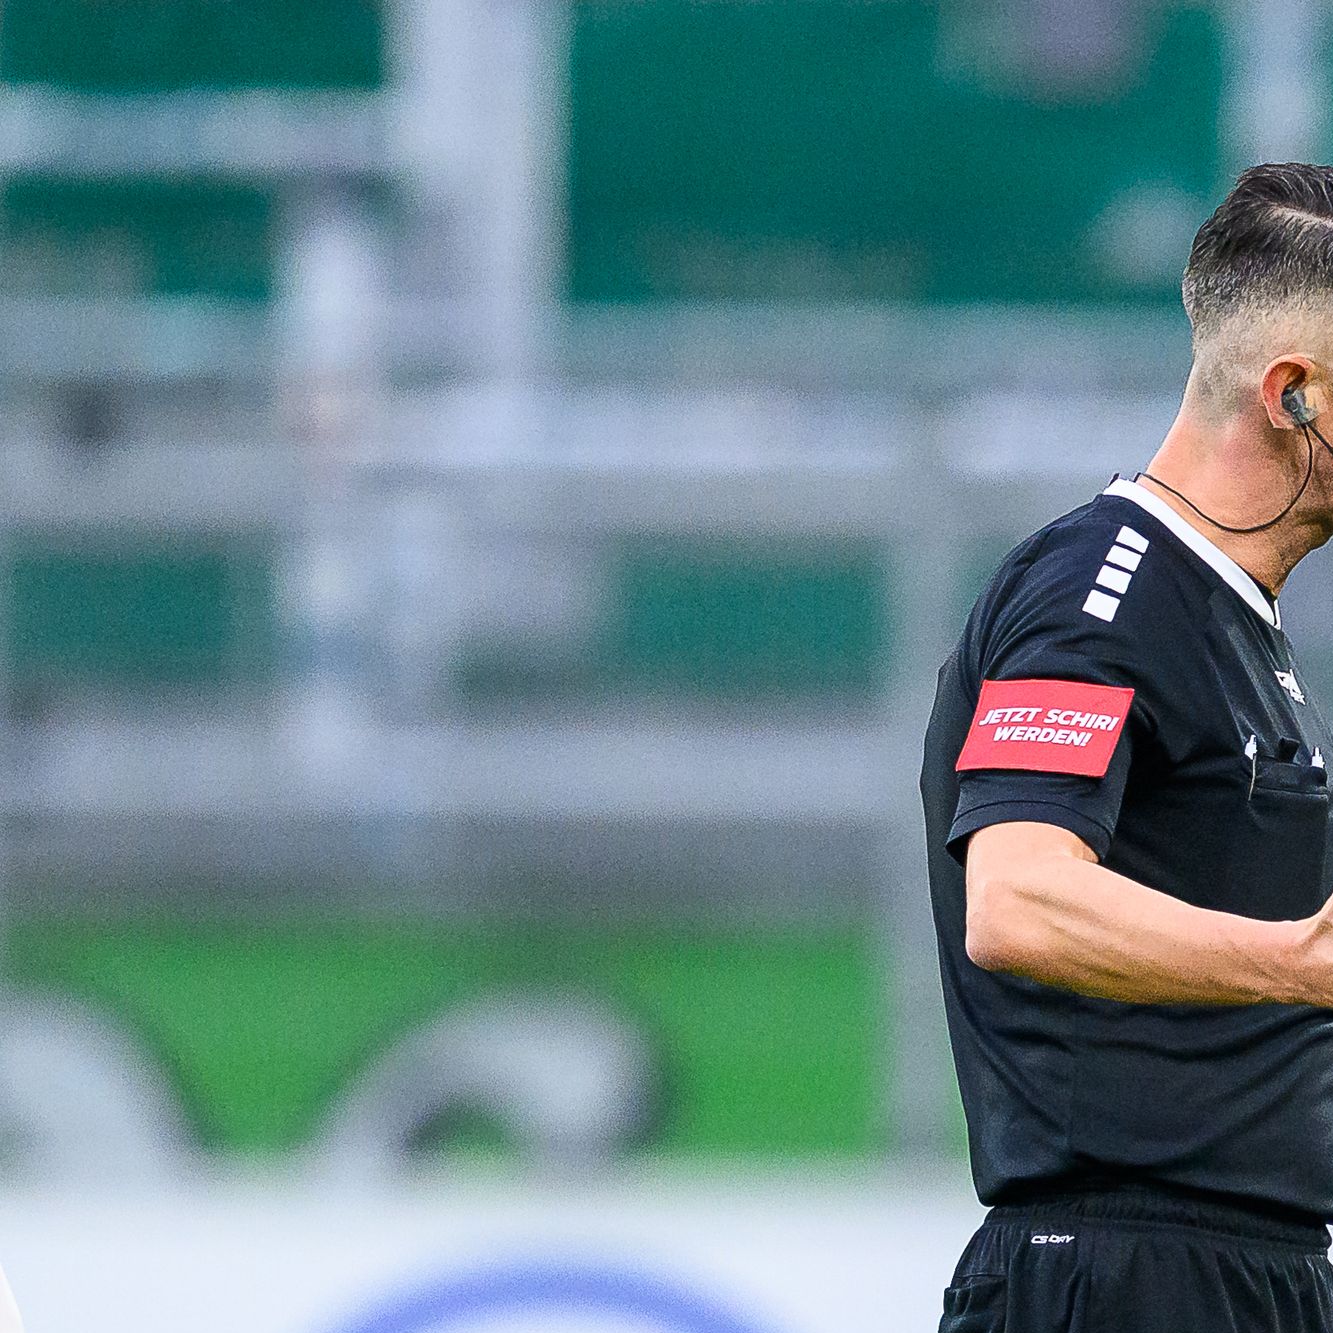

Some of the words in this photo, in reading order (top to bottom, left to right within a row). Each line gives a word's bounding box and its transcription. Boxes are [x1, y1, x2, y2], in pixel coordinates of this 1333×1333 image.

[979, 708, 1042, 725] JETZT
[1043, 709, 1120, 731] SCHIRI
[993, 726, 1092, 747] WERDEN!
